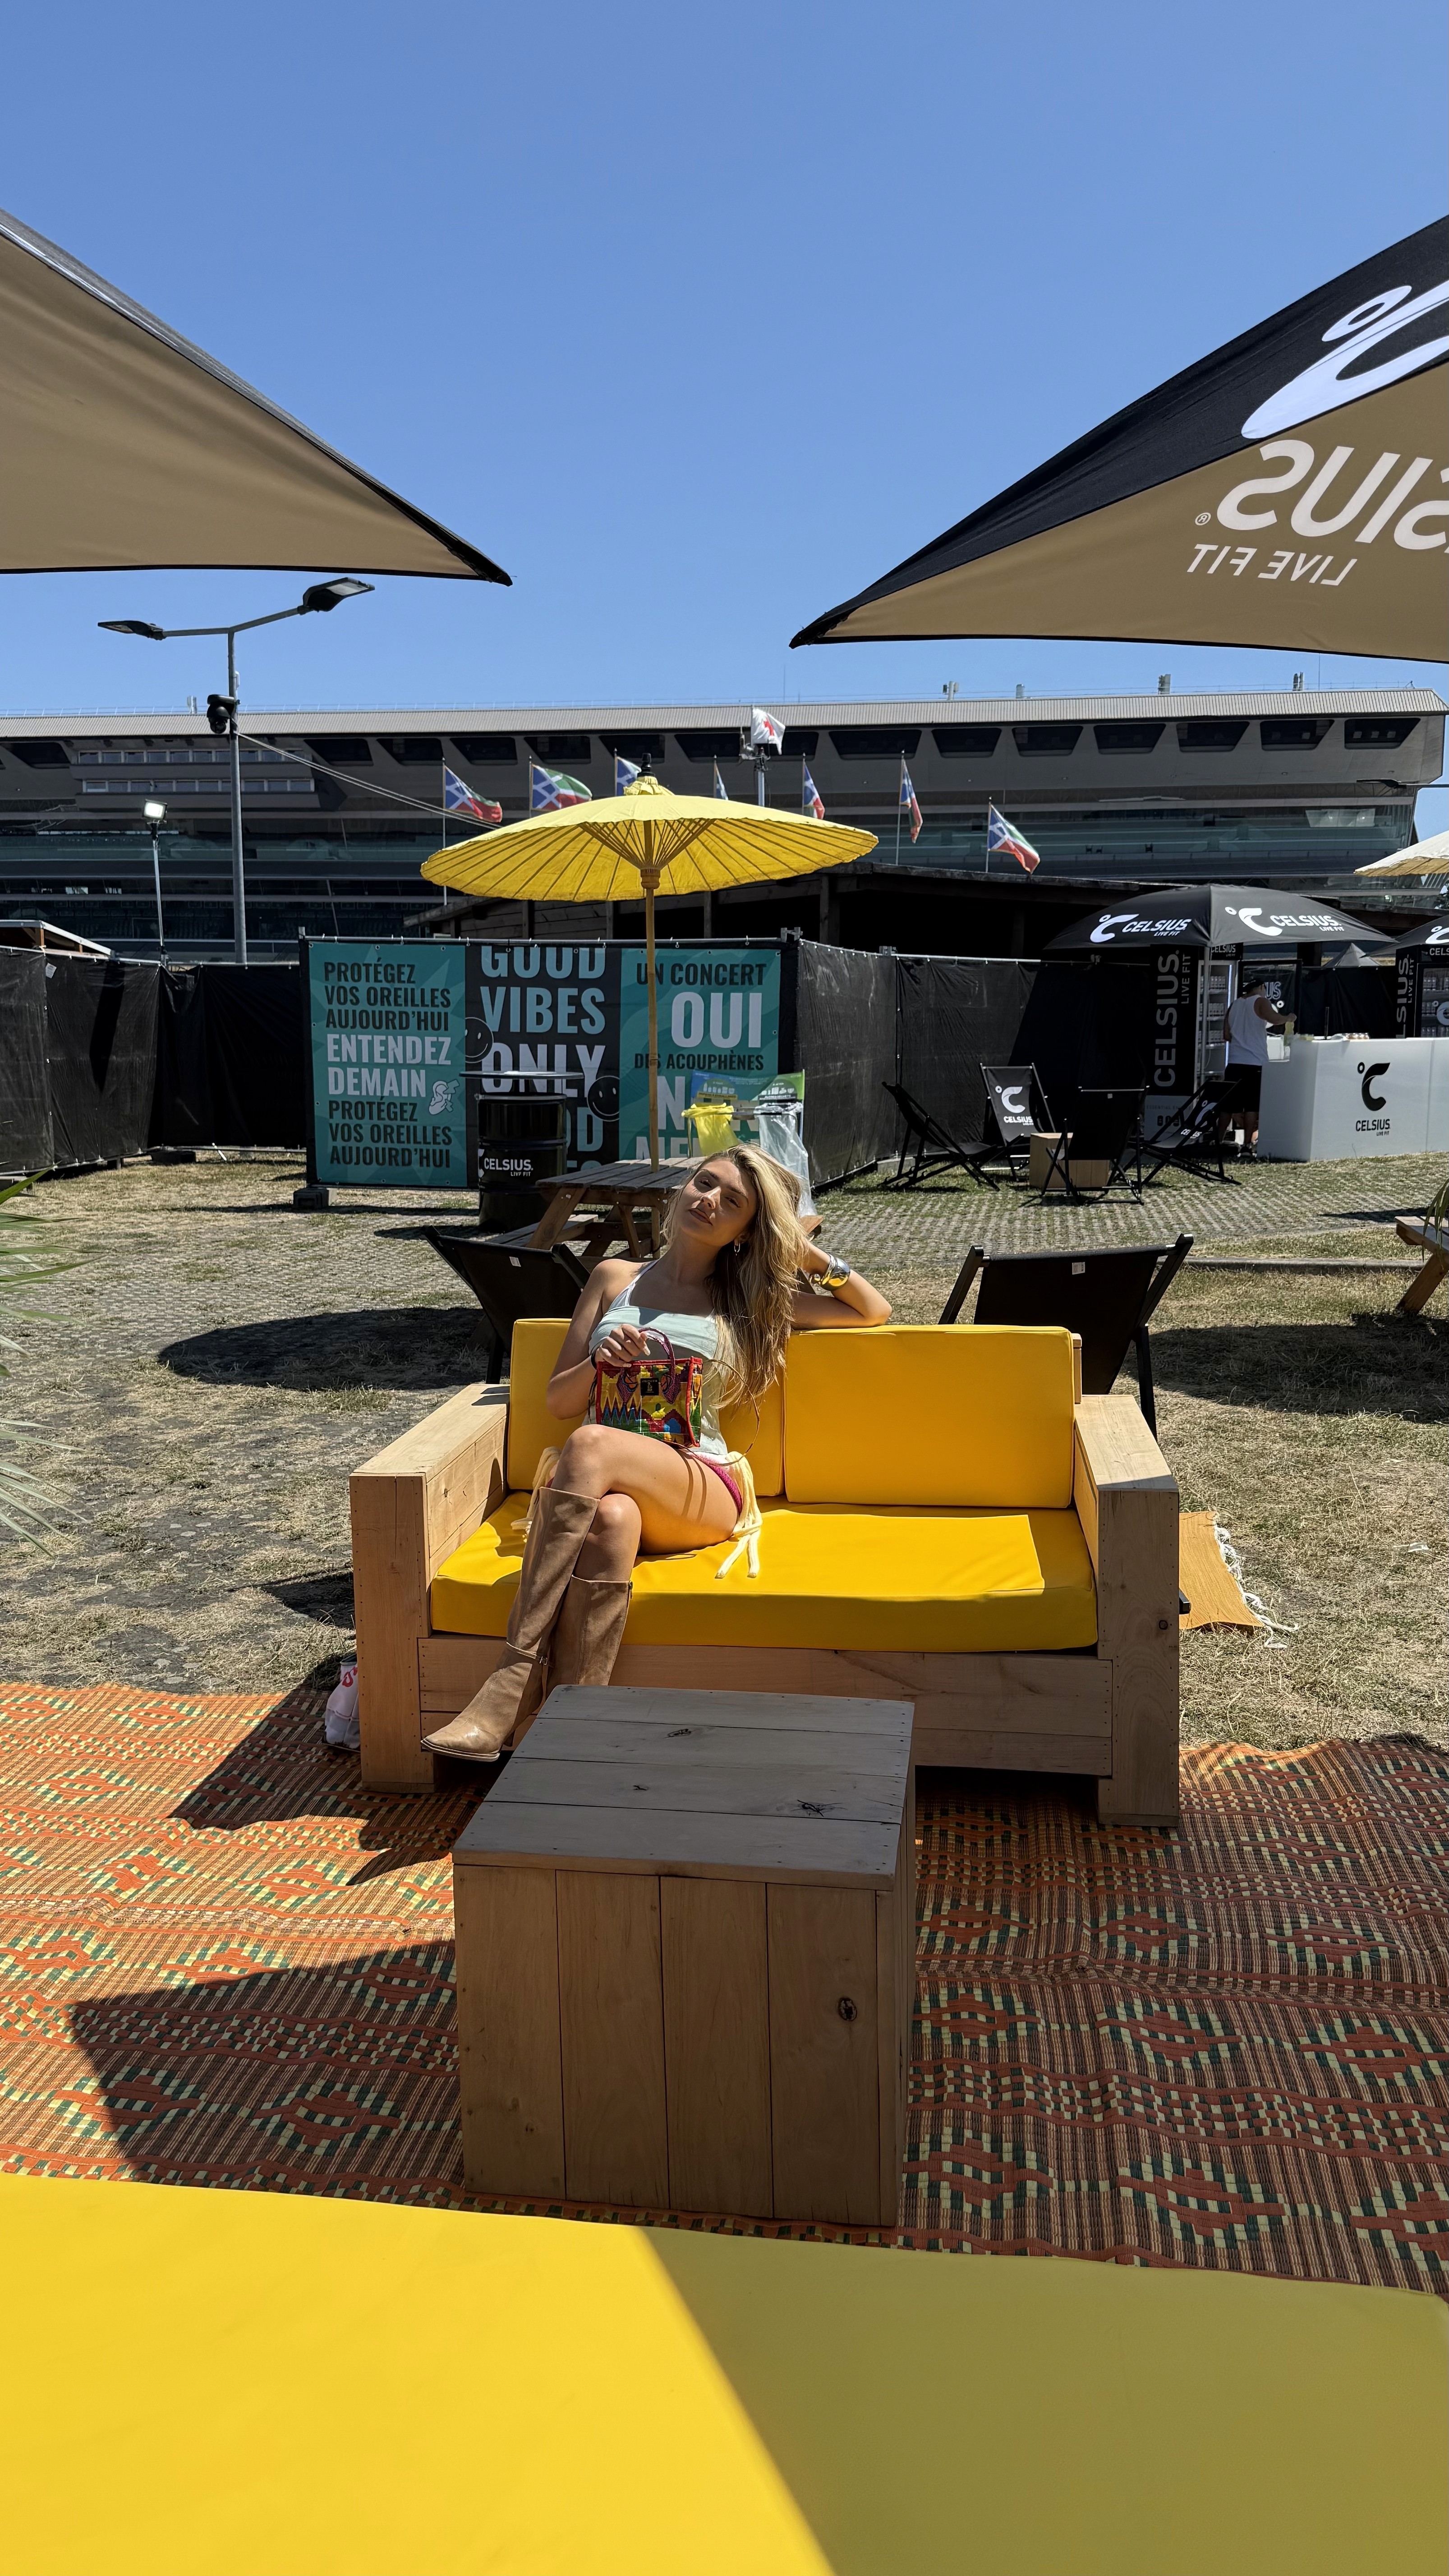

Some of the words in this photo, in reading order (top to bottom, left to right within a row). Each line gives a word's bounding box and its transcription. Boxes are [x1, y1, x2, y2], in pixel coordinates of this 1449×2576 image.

[1122, 919, 1192, 933] CELSIUS
[1270, 915, 1341, 926] CELSIUS
[1182, 953, 1191, 973] FIT
[1429, 948, 1449, 956] CELS
[324, 957, 415, 984] PROTÉGEZ
[671, 963, 767, 985] CONCERT
[324, 986, 360, 1006] VOS
[367, 987, 451, 1008] OREILLES
[1181, 978, 1190, 1004] LIVE
[326, 1009, 449, 1031] AUJOURD'HUI
[480, 986, 606, 1035] VIBES
[671, 992, 762, 1049] OUI
[1154, 953, 1179, 1087] CELSIUS
[327, 1034, 451, 1065] ENTENDEZ
[667, 1049, 764, 1071] ACOUPHÈNES
[482, 1043, 606, 1098] ONLY
[328, 1067, 426, 1098] DEMAIN
[329, 1096, 418, 1122] PROTÉGEZ
[329, 1123, 363, 1143] VOS
[370, 1124, 452, 1145] OREILLES
[1356, 1119, 1390, 1132] CELSIUS
[330, 1146, 450, 1168] AUJOURD'HUI
[484, 1158, 534, 1171] CELSIUS
